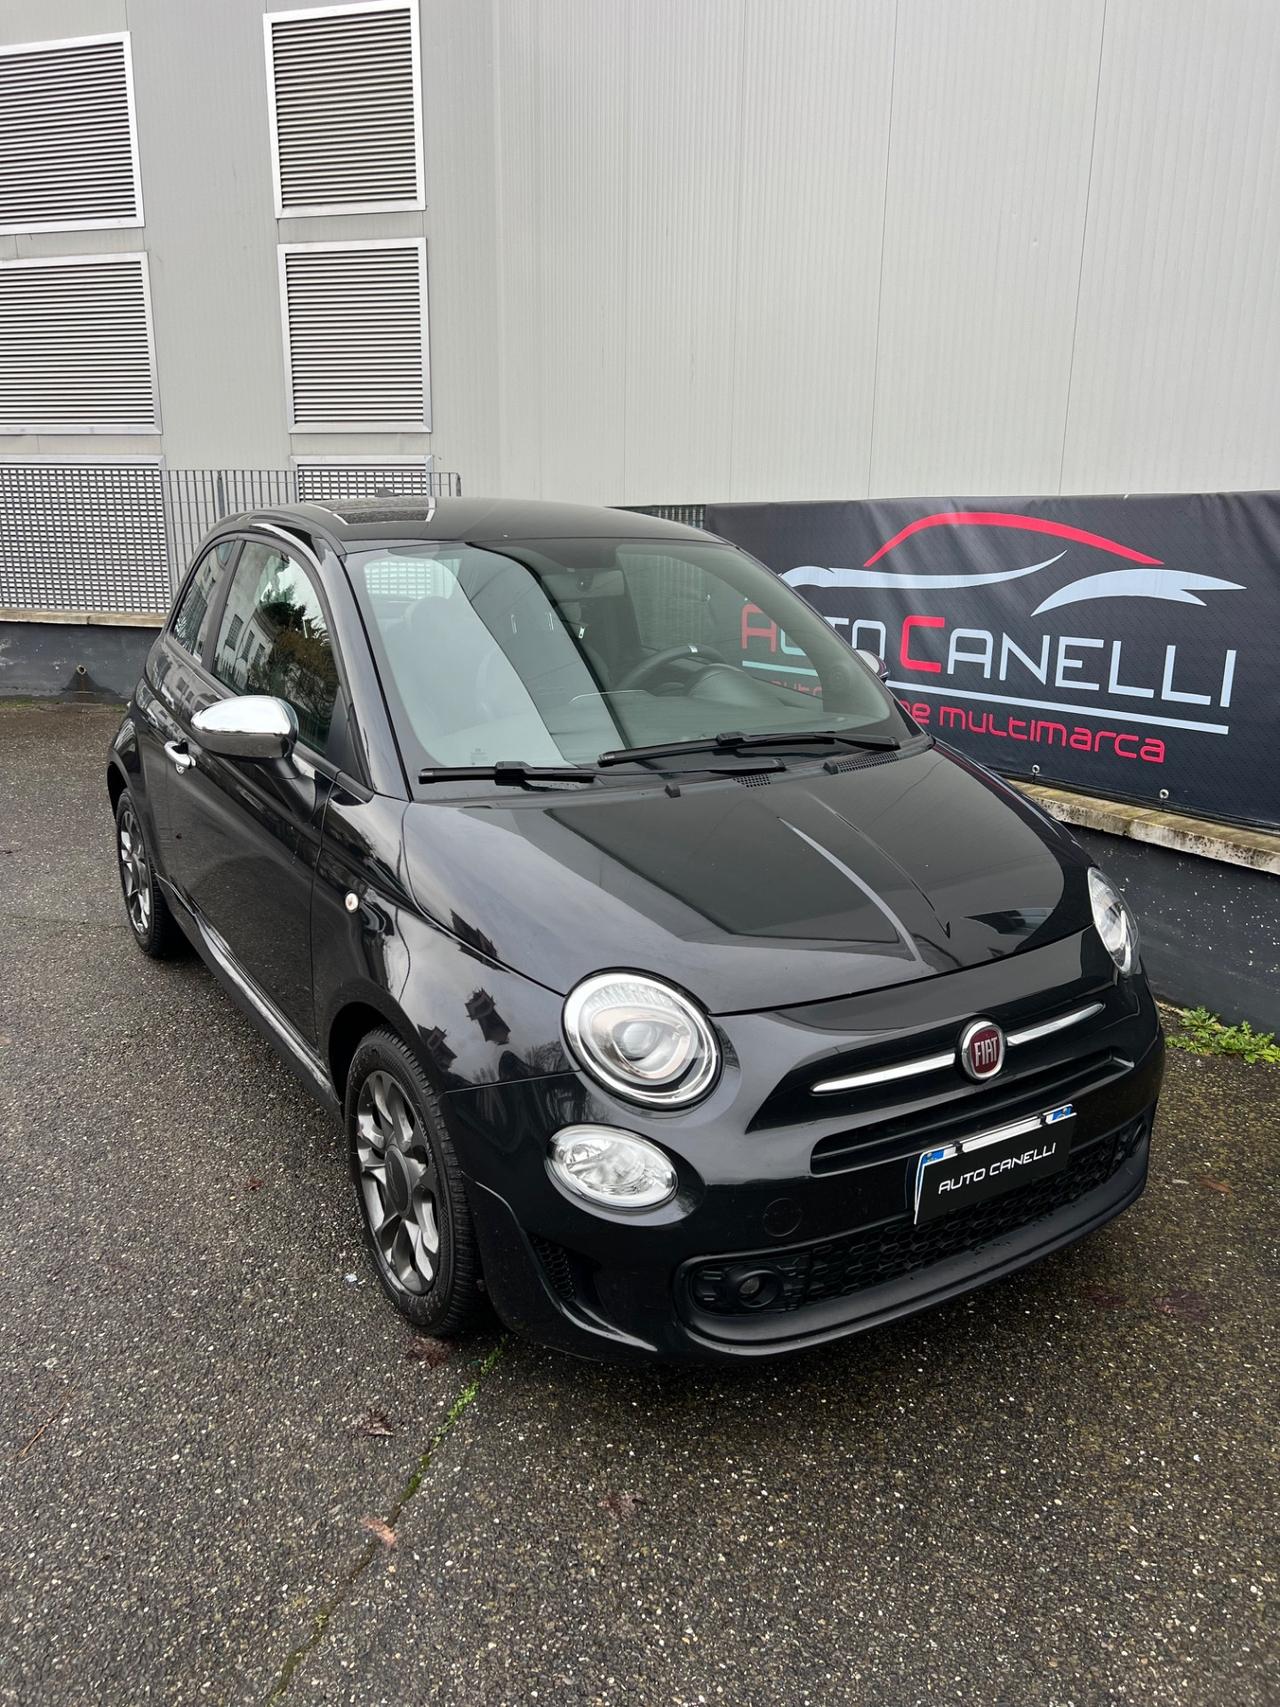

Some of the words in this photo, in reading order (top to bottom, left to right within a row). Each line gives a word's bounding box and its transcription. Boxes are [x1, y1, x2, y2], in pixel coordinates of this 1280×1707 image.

[899, 615, 1236, 708] CANELLI
[939, 706, 1165, 763] multimarca
[973, 1036, 998, 1067] FIAT
